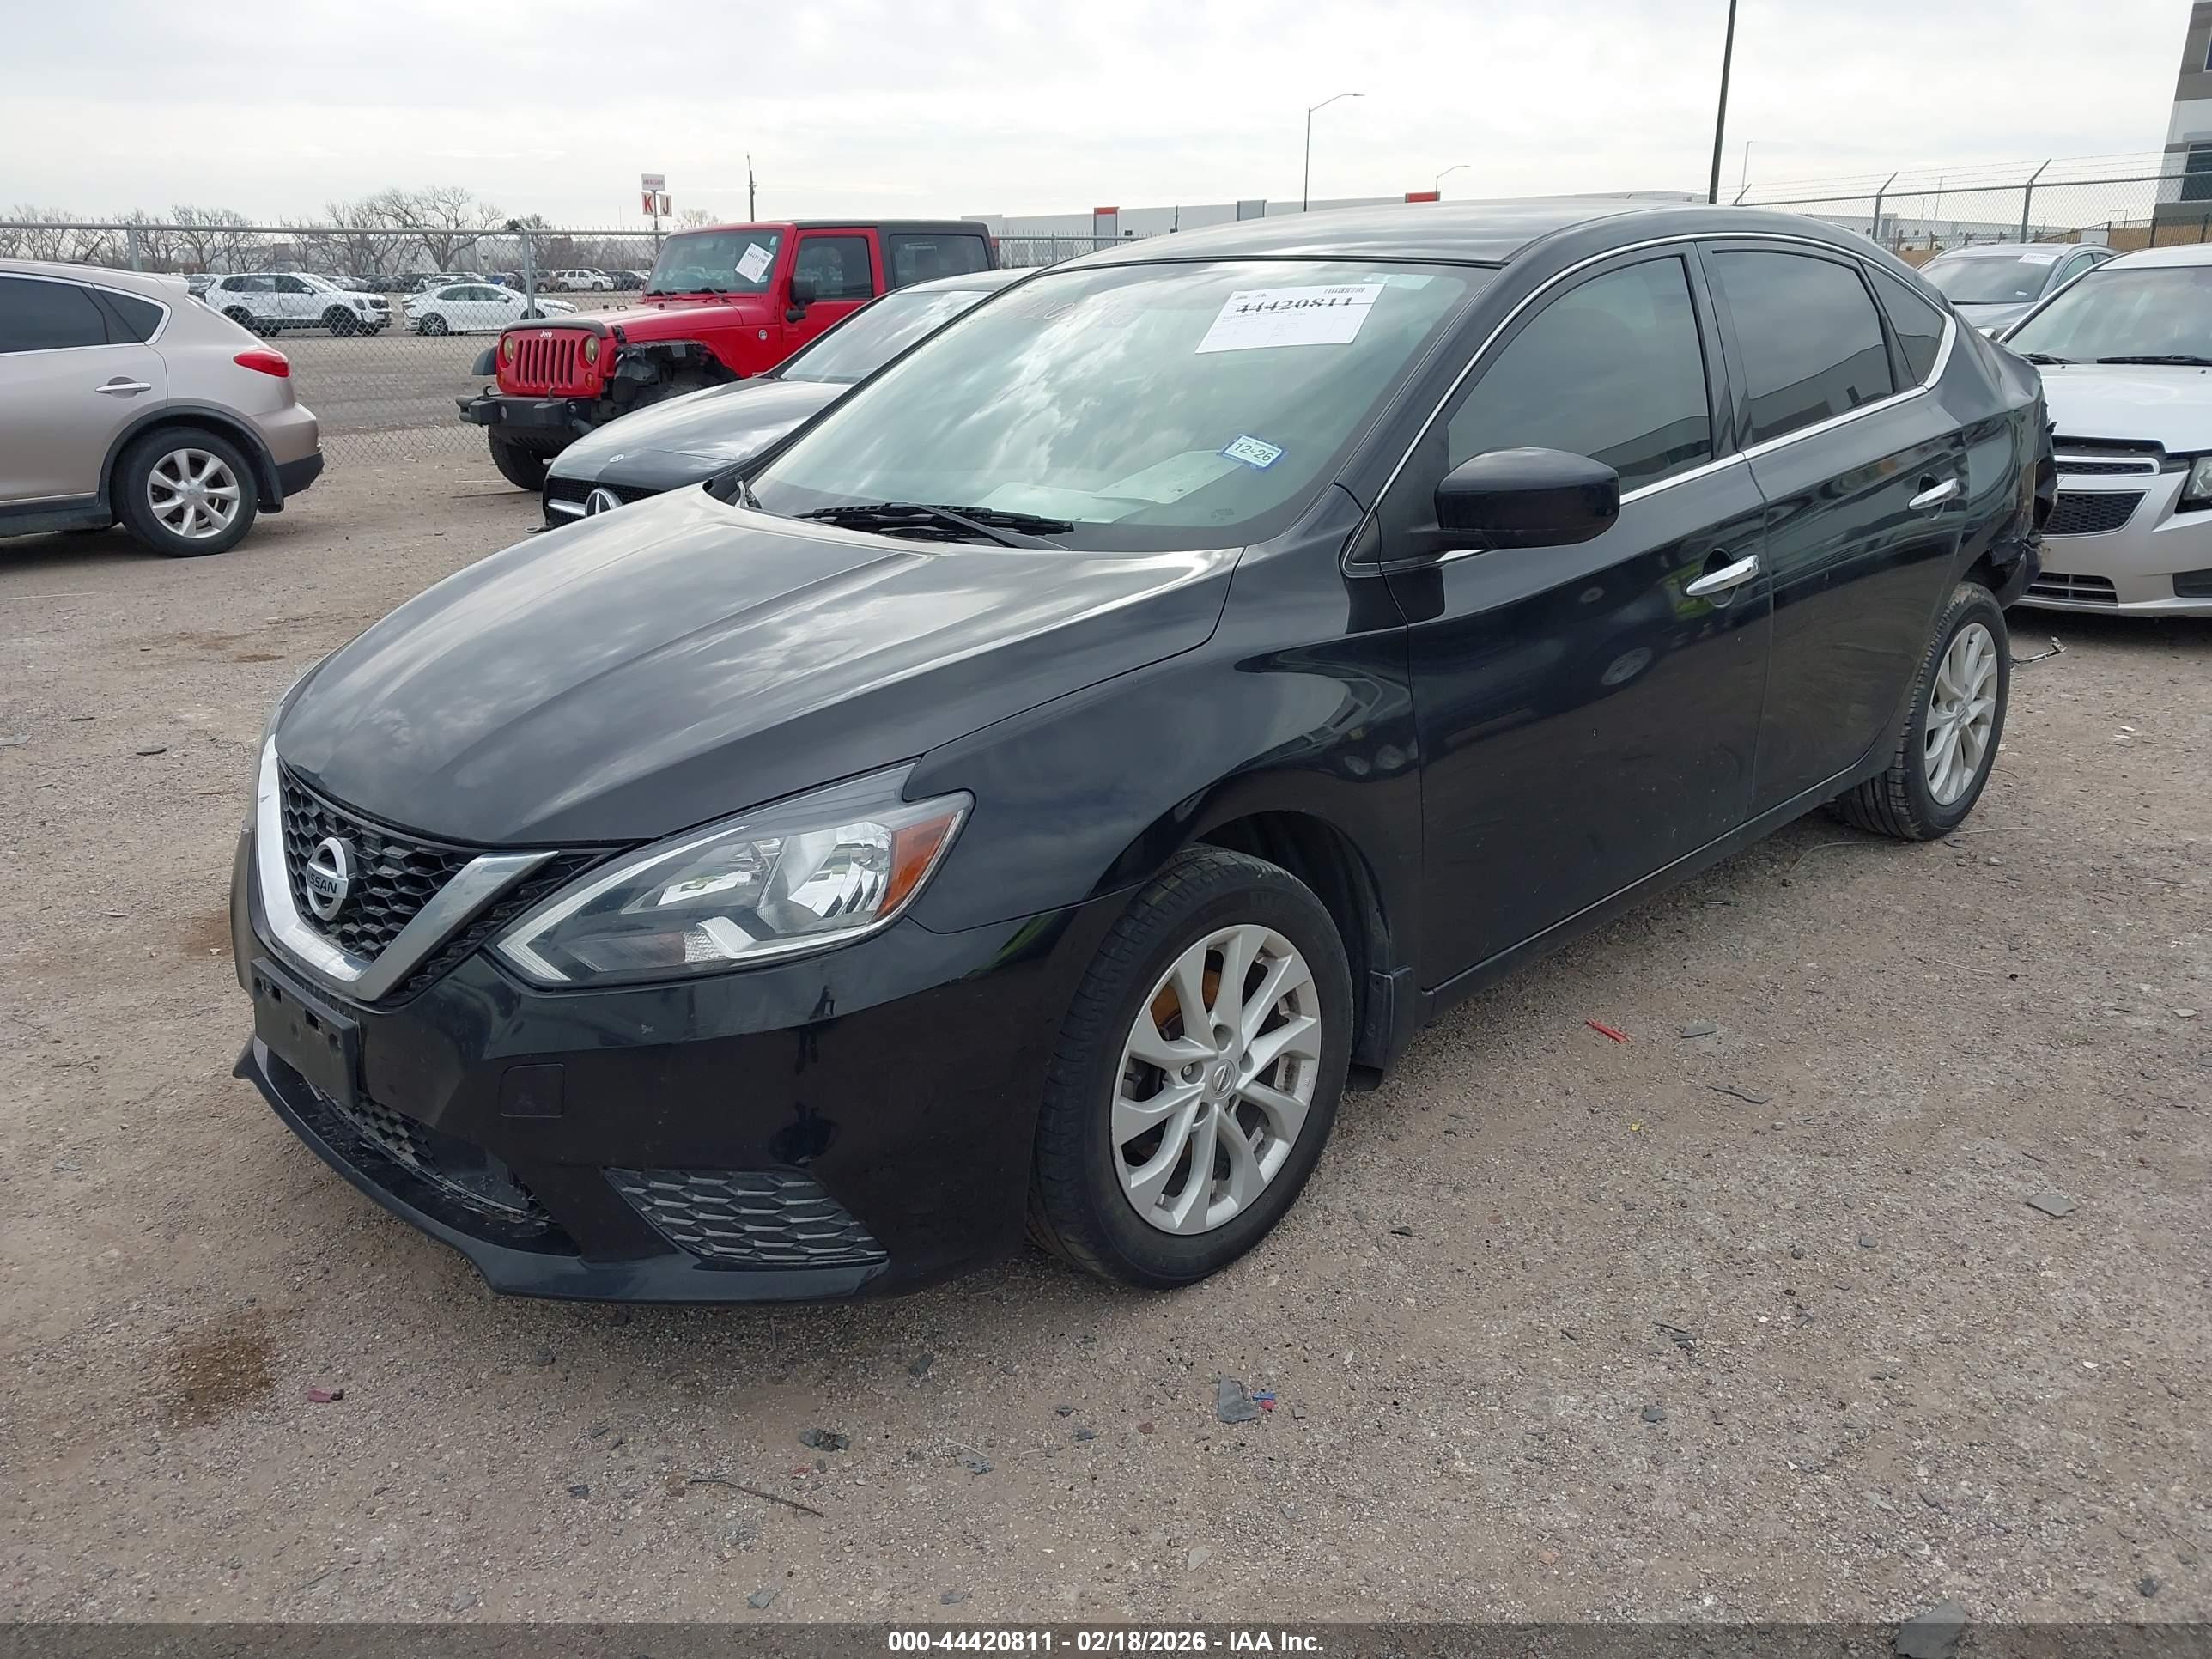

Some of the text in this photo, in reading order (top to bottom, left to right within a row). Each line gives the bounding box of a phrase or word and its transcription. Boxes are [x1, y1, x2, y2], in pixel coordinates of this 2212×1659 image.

[644, 195, 669, 215] K J
[1235, 297, 1353, 314] 44420811
